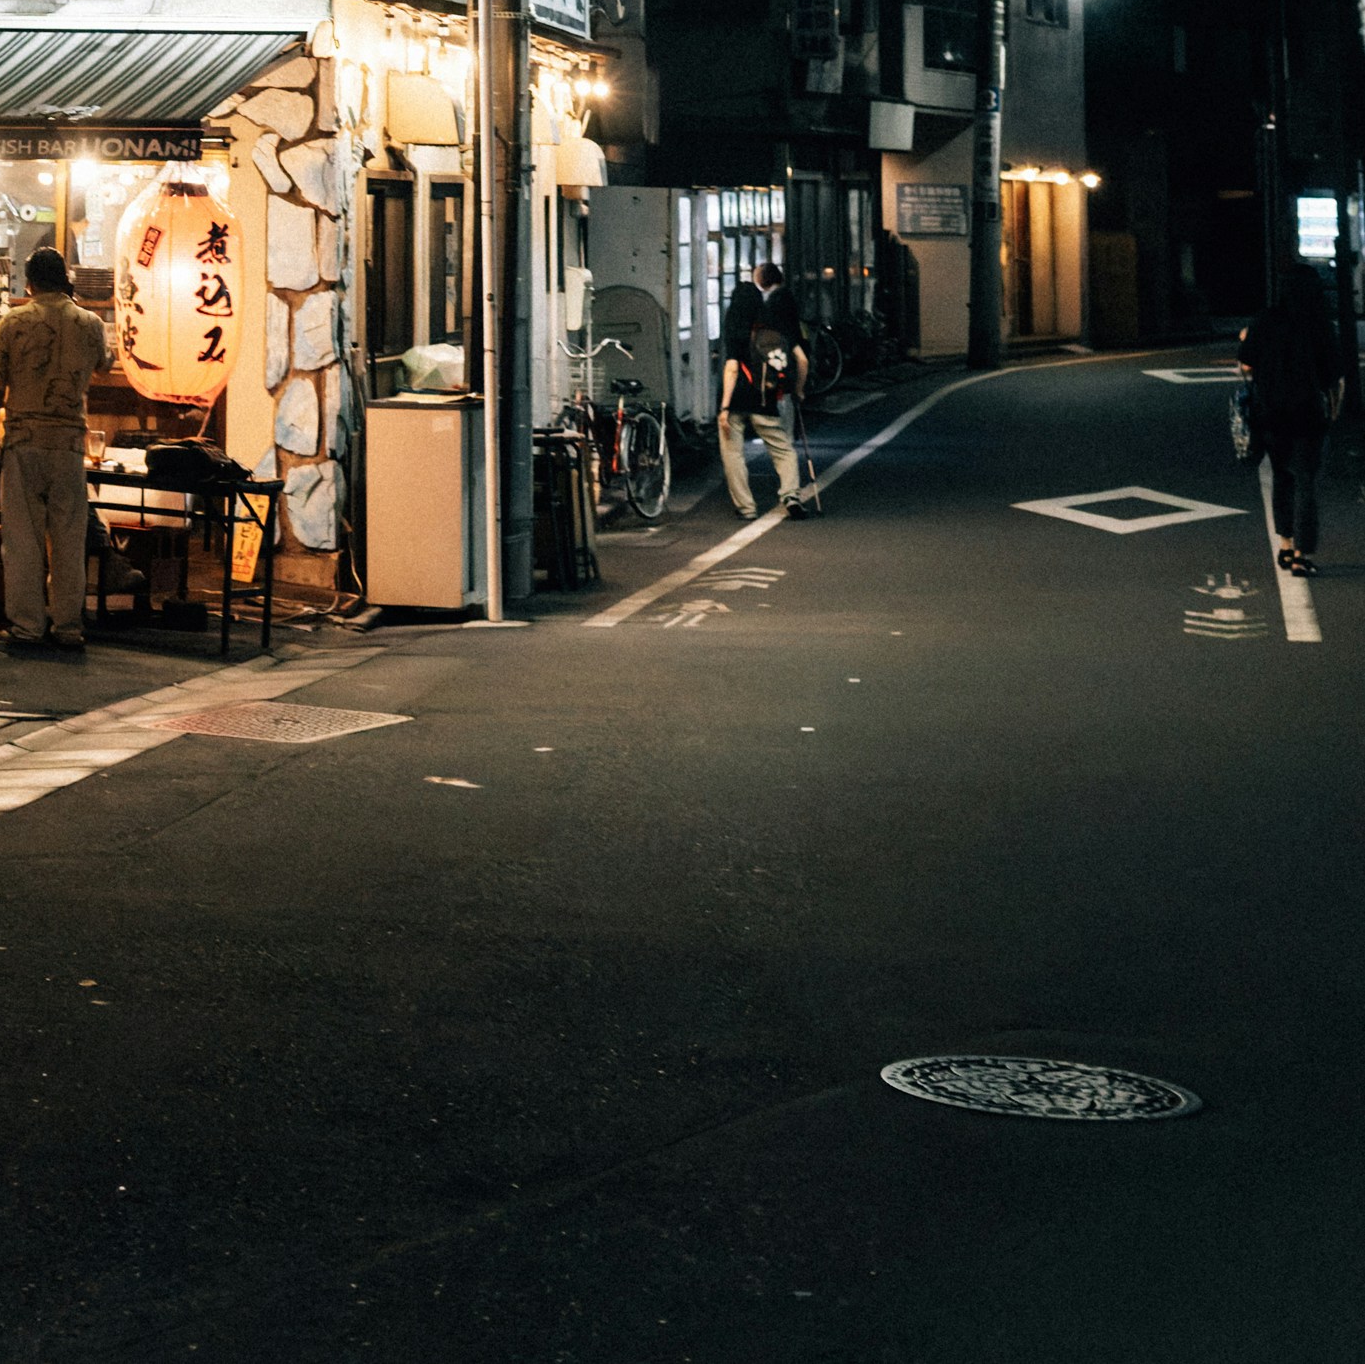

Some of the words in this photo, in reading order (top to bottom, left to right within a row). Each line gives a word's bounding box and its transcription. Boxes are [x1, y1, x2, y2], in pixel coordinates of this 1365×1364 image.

[38, 139, 75, 156] BAR
[196, 221, 234, 365] 煮込み
